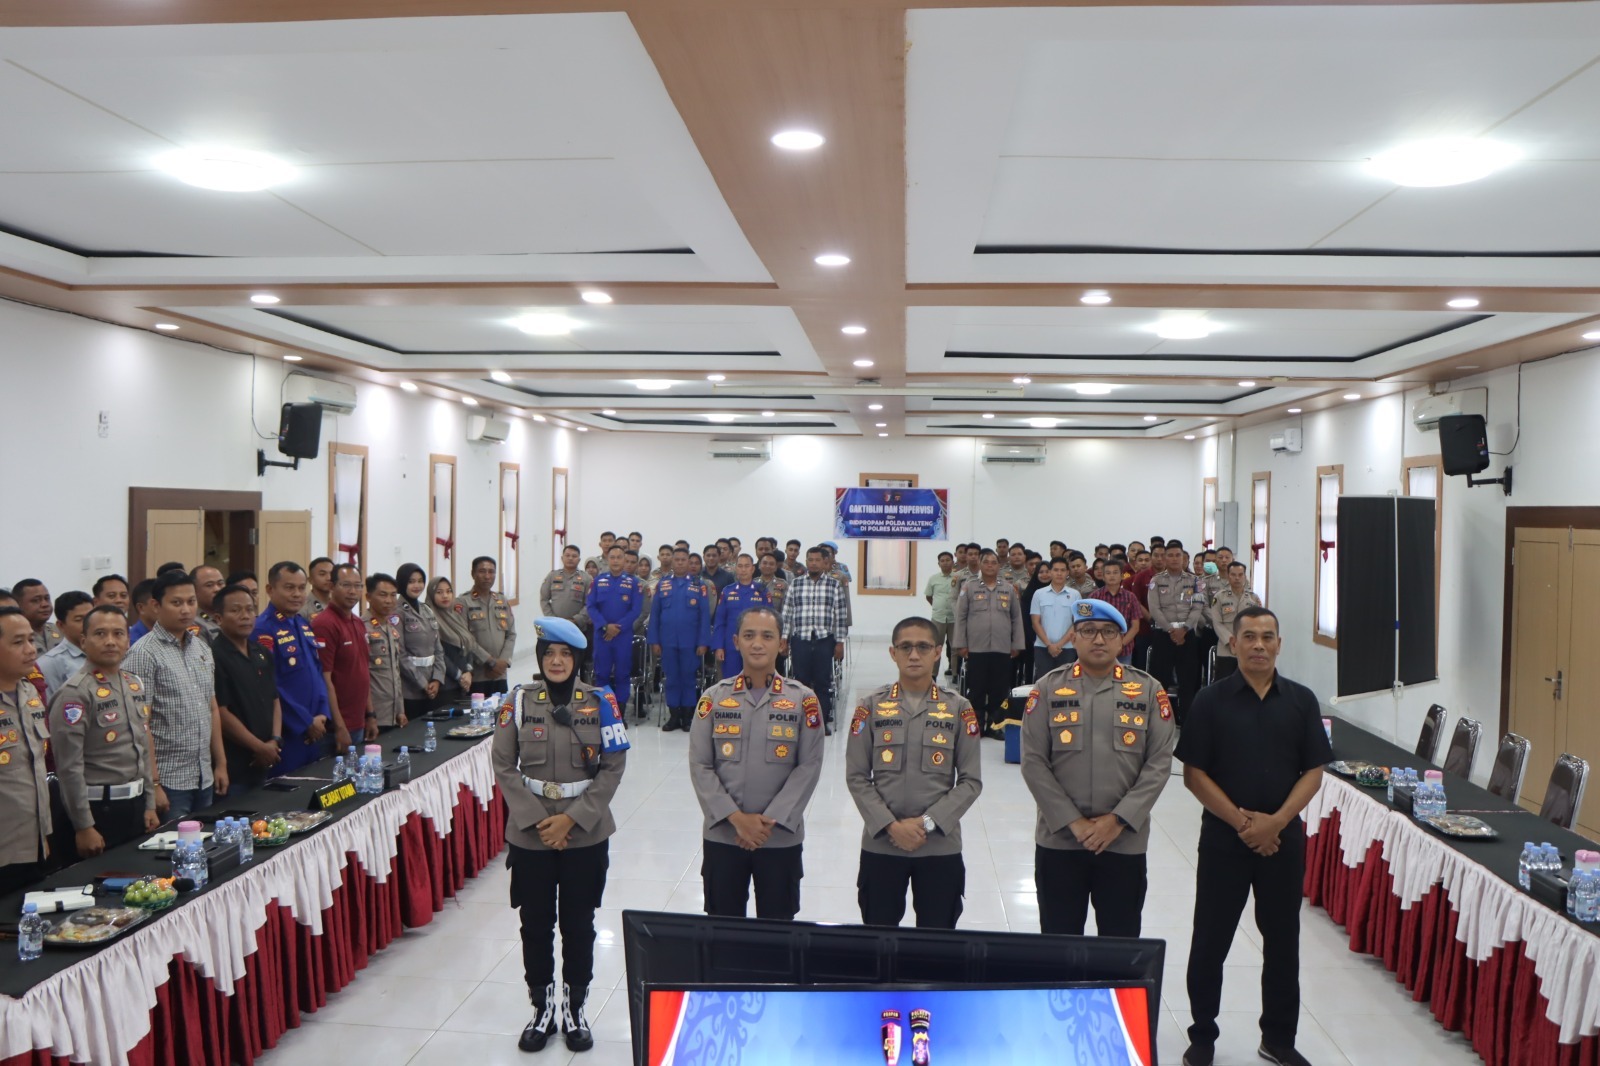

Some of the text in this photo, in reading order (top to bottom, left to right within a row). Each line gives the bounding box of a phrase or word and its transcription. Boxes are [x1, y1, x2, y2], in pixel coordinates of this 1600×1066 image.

[849, 504, 933, 514] GAKTIBLIN DAN SUPERVISI
[97, 699, 118, 711] JUWITO
[1116, 701, 1146, 711] POLRI
[769, 714, 798, 722] POLRI
[875, 720, 902, 728] NUGROHO
[926, 721, 954, 730] POLRI
[601, 722, 628, 748] PR
[320, 788, 342, 808] PEJABAT
